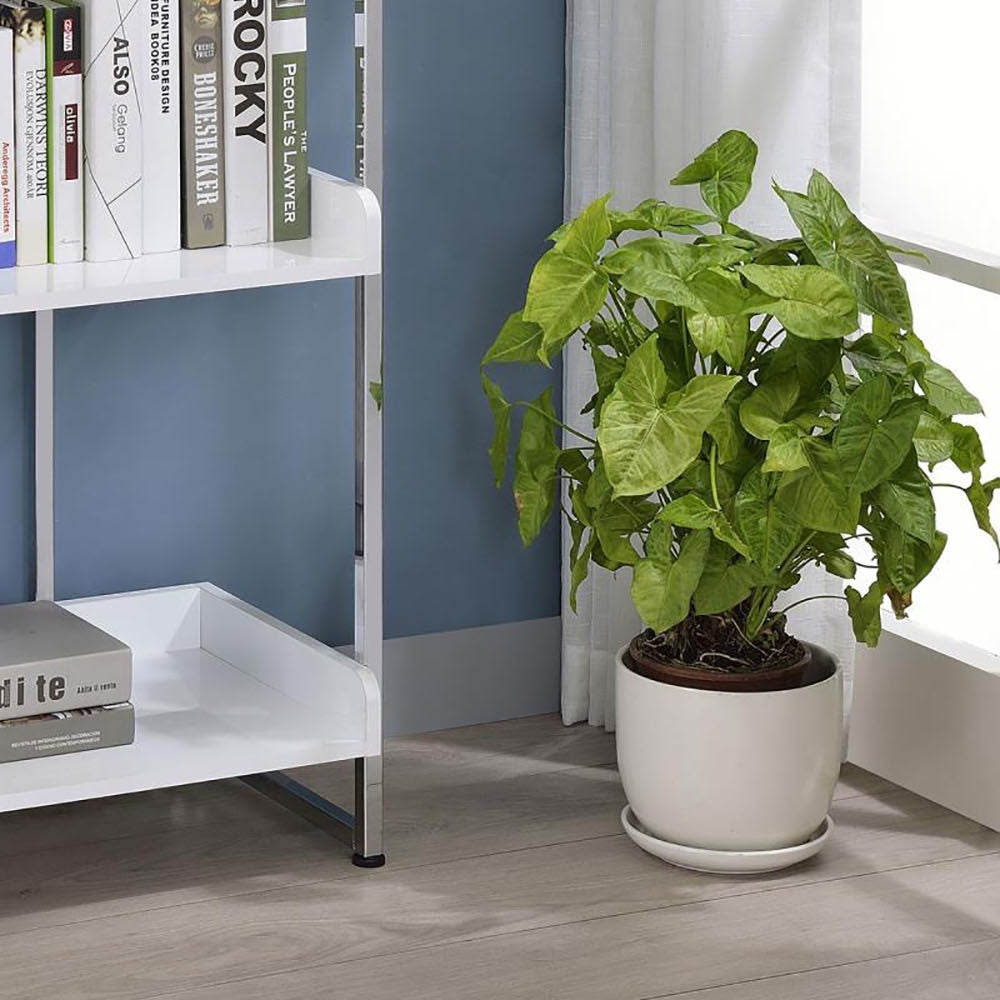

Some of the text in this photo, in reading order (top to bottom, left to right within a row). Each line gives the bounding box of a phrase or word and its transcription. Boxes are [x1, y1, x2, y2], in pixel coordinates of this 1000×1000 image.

[113, 37, 129, 95] ALSO
[150, 33, 160, 80] BOOK08
[24, 71, 34, 123] EVOLUSJON
[161, 69, 170, 114] DESIGN
[24, 126, 35, 171] GJENNOM
[35, 69, 48, 197] DARWINS TEORI
[66, 107, 76, 143] olivia
[114, 103, 128, 153] Gelang
[194, 71, 219, 206] BONESHAKER
[283, 63, 297, 223] PEOPLE'S LAWYER
[1, 142, 11, 233] Anderegg Architects
[36, 675, 65, 703] te
